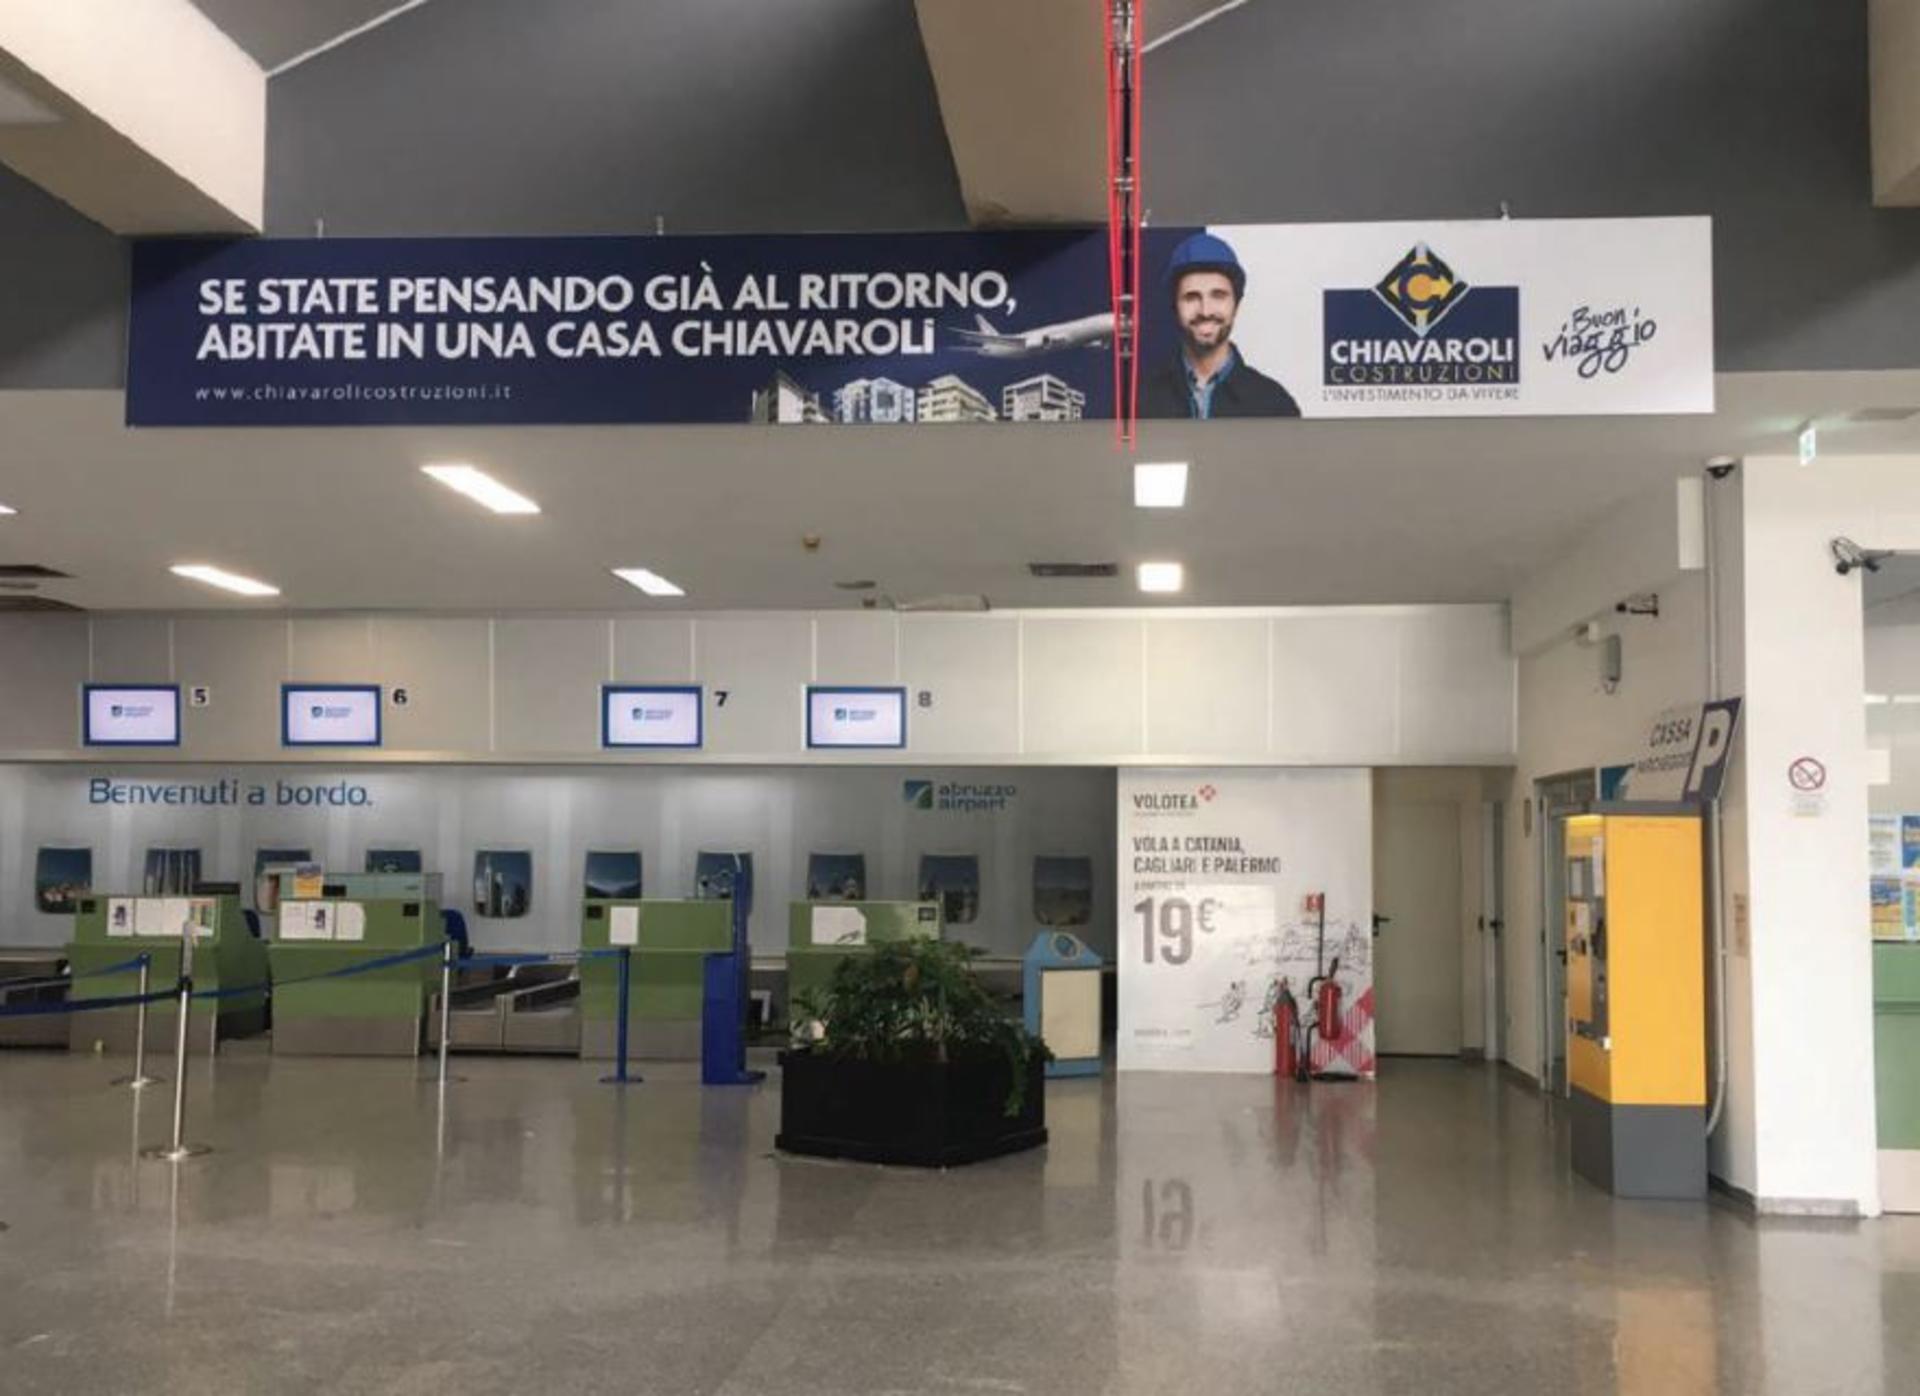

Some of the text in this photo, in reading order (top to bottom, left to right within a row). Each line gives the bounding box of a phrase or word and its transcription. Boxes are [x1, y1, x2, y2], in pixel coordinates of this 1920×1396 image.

[199, 261, 1017, 315] SE STATE PENSANDO GIÀ AL RITORNO,
[1572, 306, 1626, 332] Buon
[196, 322, 366, 360] ABITATE
[377, 322, 423, 359] IN
[436, 321, 535, 358] UNA
[546, 319, 661, 358] CASA
[1330, 337, 1514, 364] CHIAVAROLI
[1330, 364, 1515, 384] COSTRUZIONI
[196, 385, 512, 401] www.chiavarolicostruzioni.it
[1322, 386, 1520, 402] L'INVESTIMENTO DA VIVERE
[194, 688, 207, 704] 5
[393, 688, 408, 705] 6
[714, 691, 729, 707] 7
[918, 691, 932, 707] 8
[1687, 709, 1731, 793] P
[89, 779, 373, 807] Benvenuti a bordo.
[1133, 793, 1199, 810] VOLOTEA
[1133, 836, 1169, 852] VOLA
[1172, 837, 1180, 851] A
[1133, 857, 1282, 874] CAGLIARI E PALERMO
